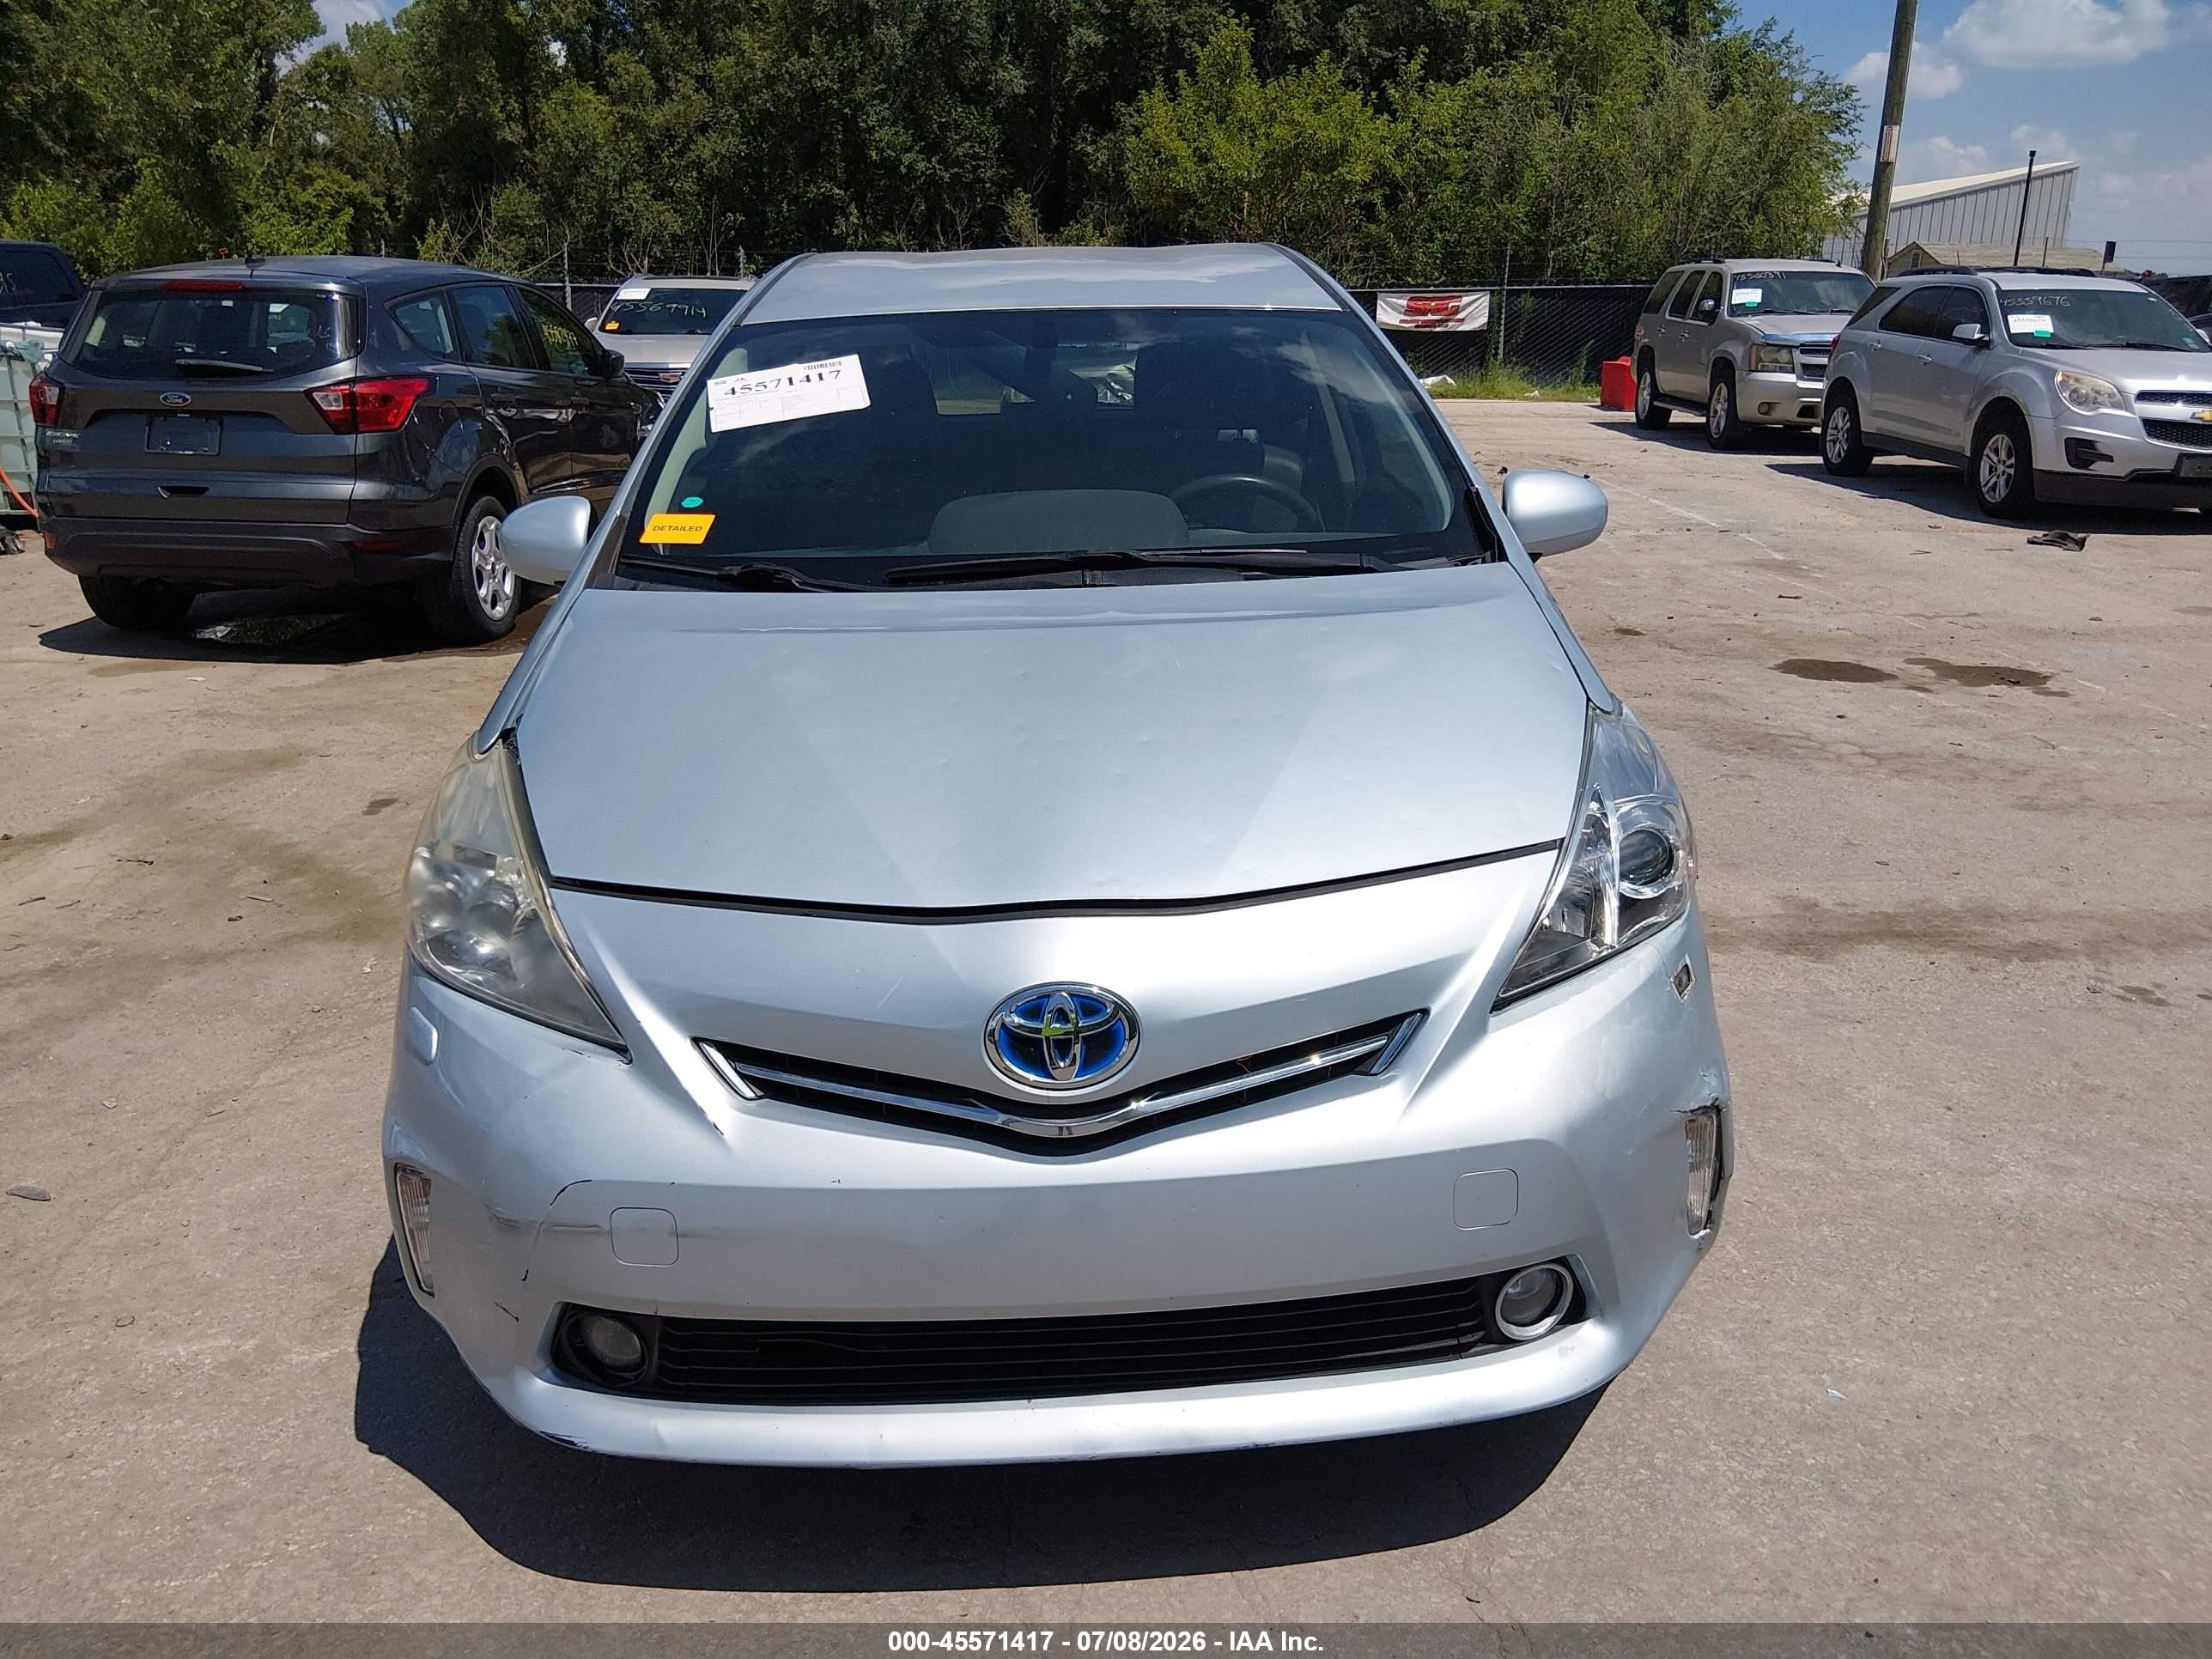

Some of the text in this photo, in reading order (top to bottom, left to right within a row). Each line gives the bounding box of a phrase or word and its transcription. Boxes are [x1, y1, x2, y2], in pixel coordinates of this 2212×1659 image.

[1999, 295, 2070, 307] 45559676
[611, 301, 706, 318] 45569914
[724, 369, 842, 396] 45571417
[166, 395, 184, 404] Ford
